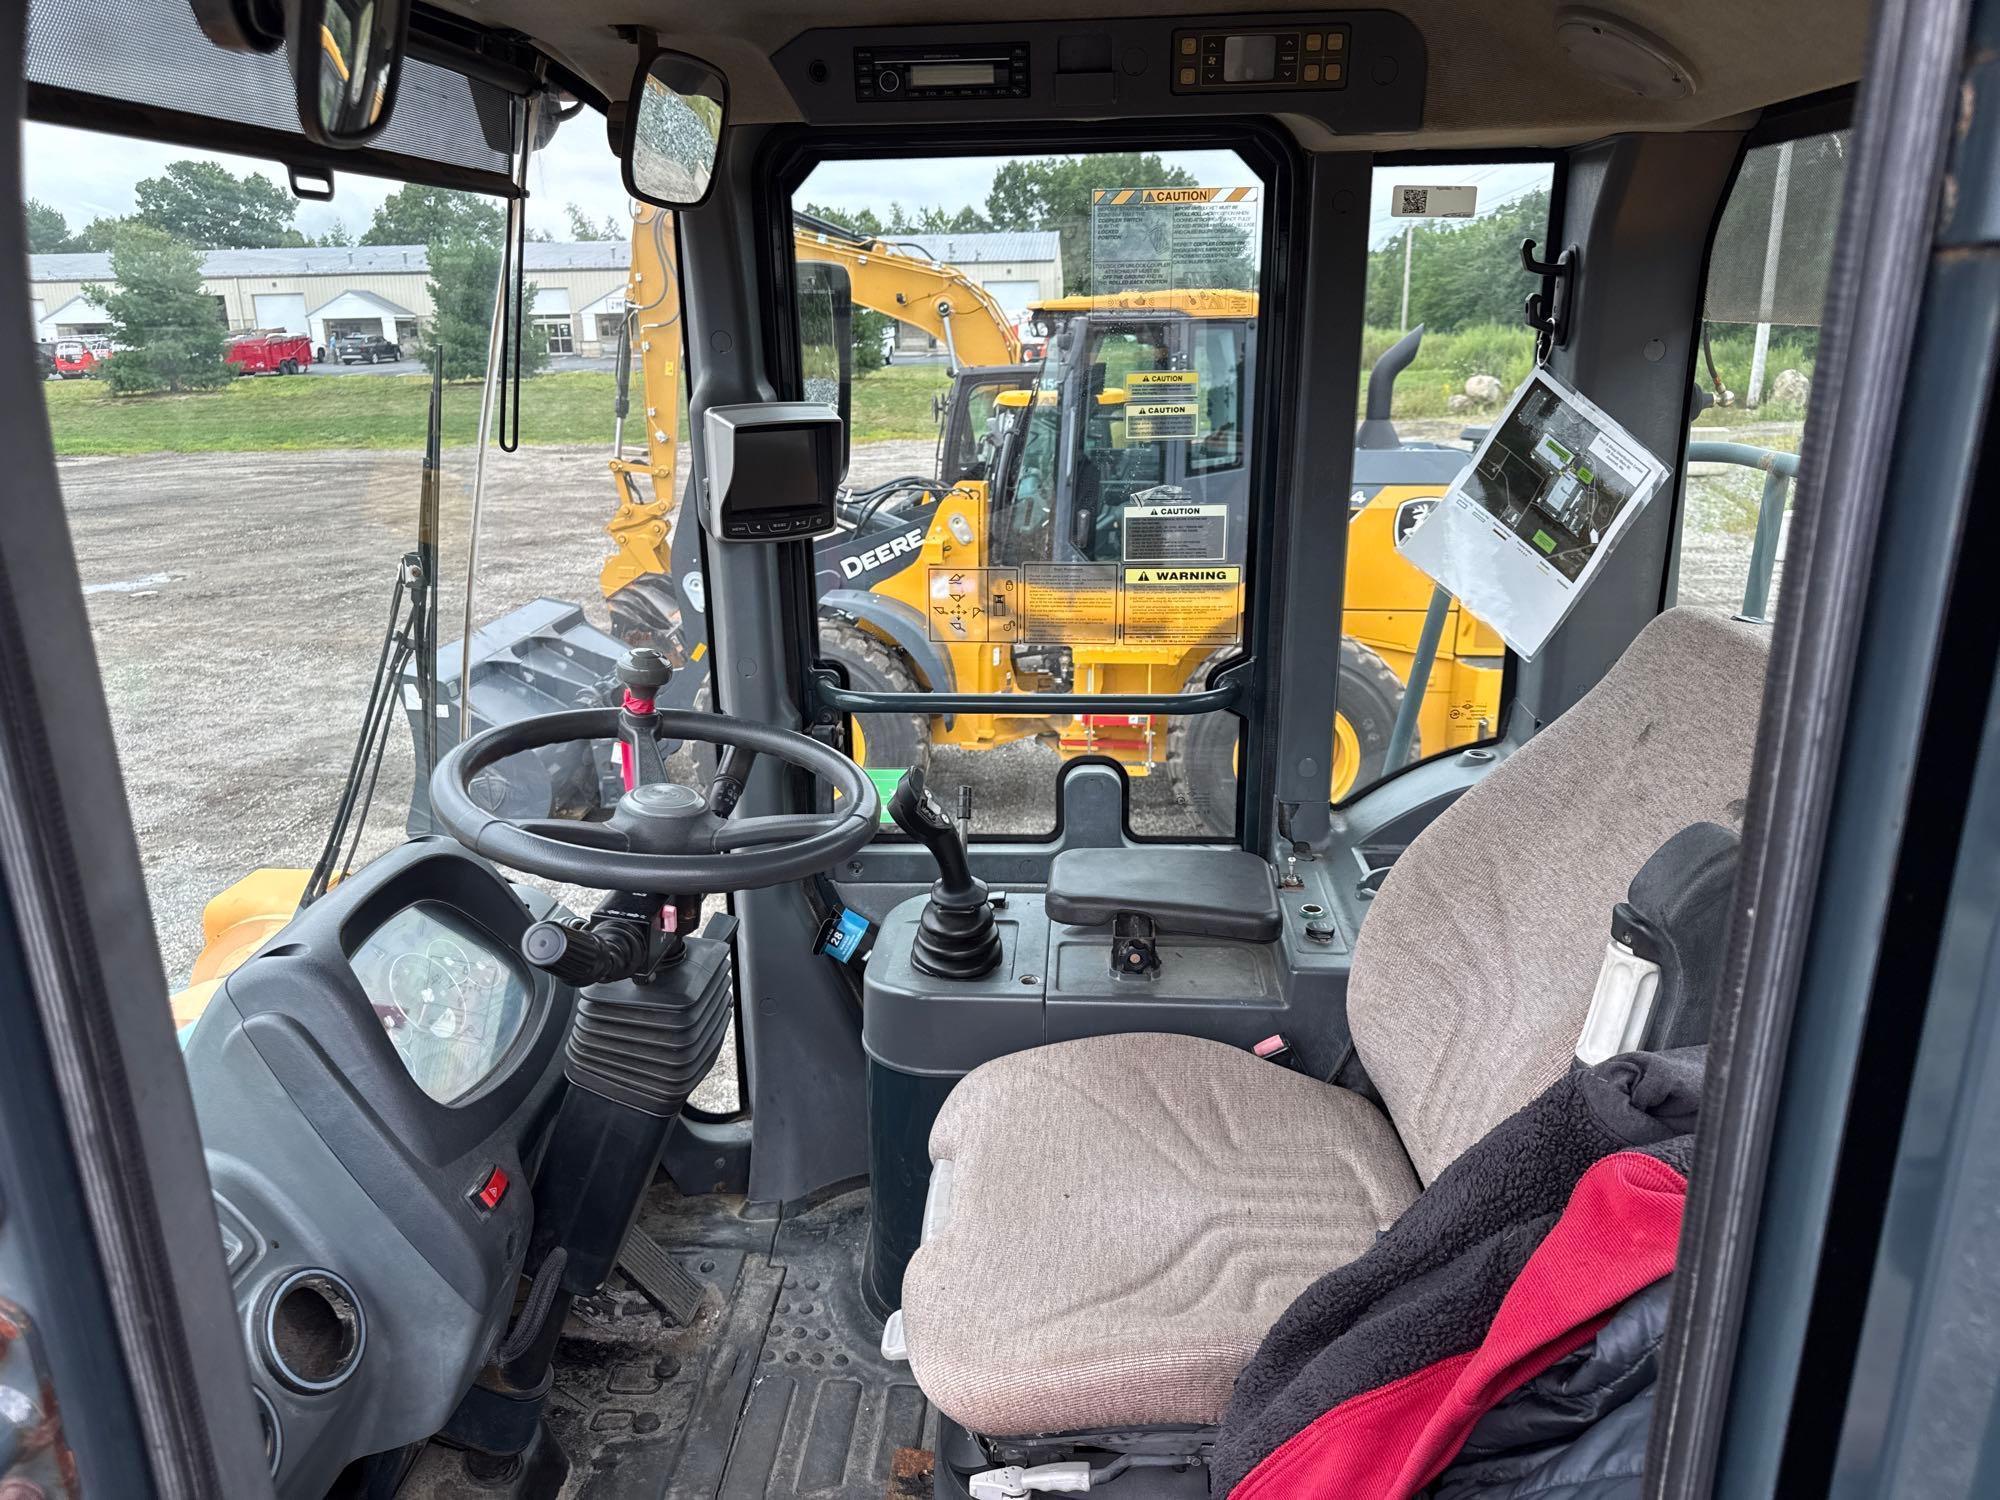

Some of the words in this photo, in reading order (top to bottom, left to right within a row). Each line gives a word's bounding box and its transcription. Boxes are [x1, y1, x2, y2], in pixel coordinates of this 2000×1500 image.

[1156, 190, 1208, 202] CAUTION
[1148, 406, 1186, 414] CAUTION
[1161, 507, 1200, 515] CAUTION
[840, 528, 926, 580] DEERE
[1156, 571, 1227, 581] WARNING
[831, 931, 844, 946] 28
